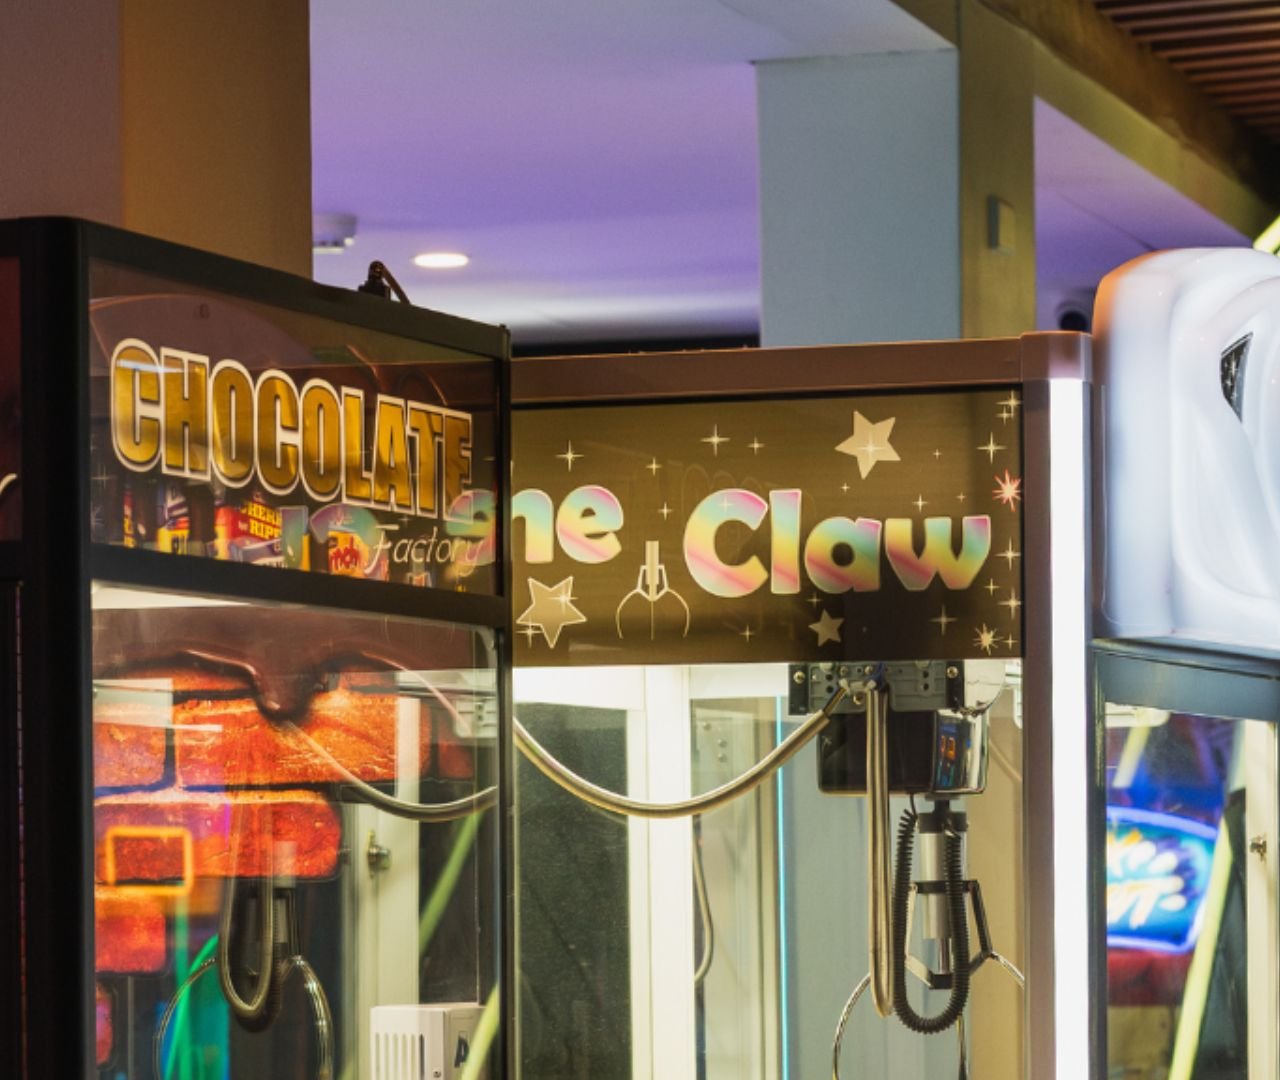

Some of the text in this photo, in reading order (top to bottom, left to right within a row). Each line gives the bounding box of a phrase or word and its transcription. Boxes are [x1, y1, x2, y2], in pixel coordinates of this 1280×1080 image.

[110, 338, 473, 524] CHOCOLATE
[364, 524, 484, 577] Factory
[683, 487, 991, 598] Claw
